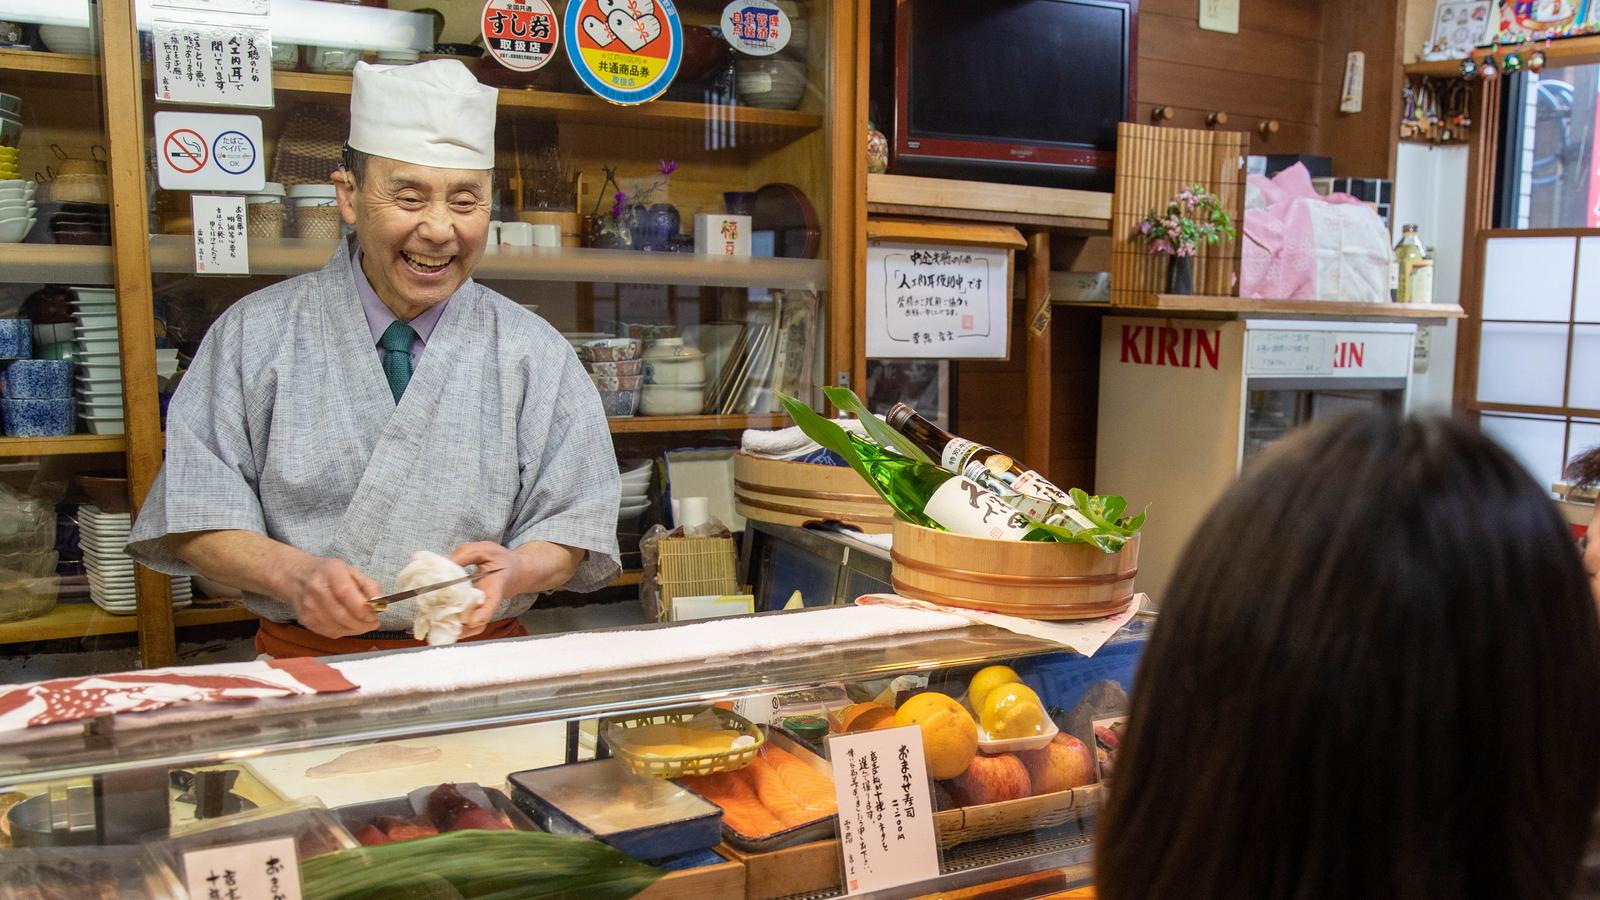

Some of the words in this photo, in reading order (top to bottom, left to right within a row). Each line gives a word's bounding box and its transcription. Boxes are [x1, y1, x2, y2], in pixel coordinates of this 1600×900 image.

[488, 11, 550, 39] すし券
[500, 39, 541, 53] 取扱店
[598, 61, 650, 78] 共通商品券
[1120, 324, 1221, 370] KIRIN
[898, 745, 915, 818] おまかせ寿司
